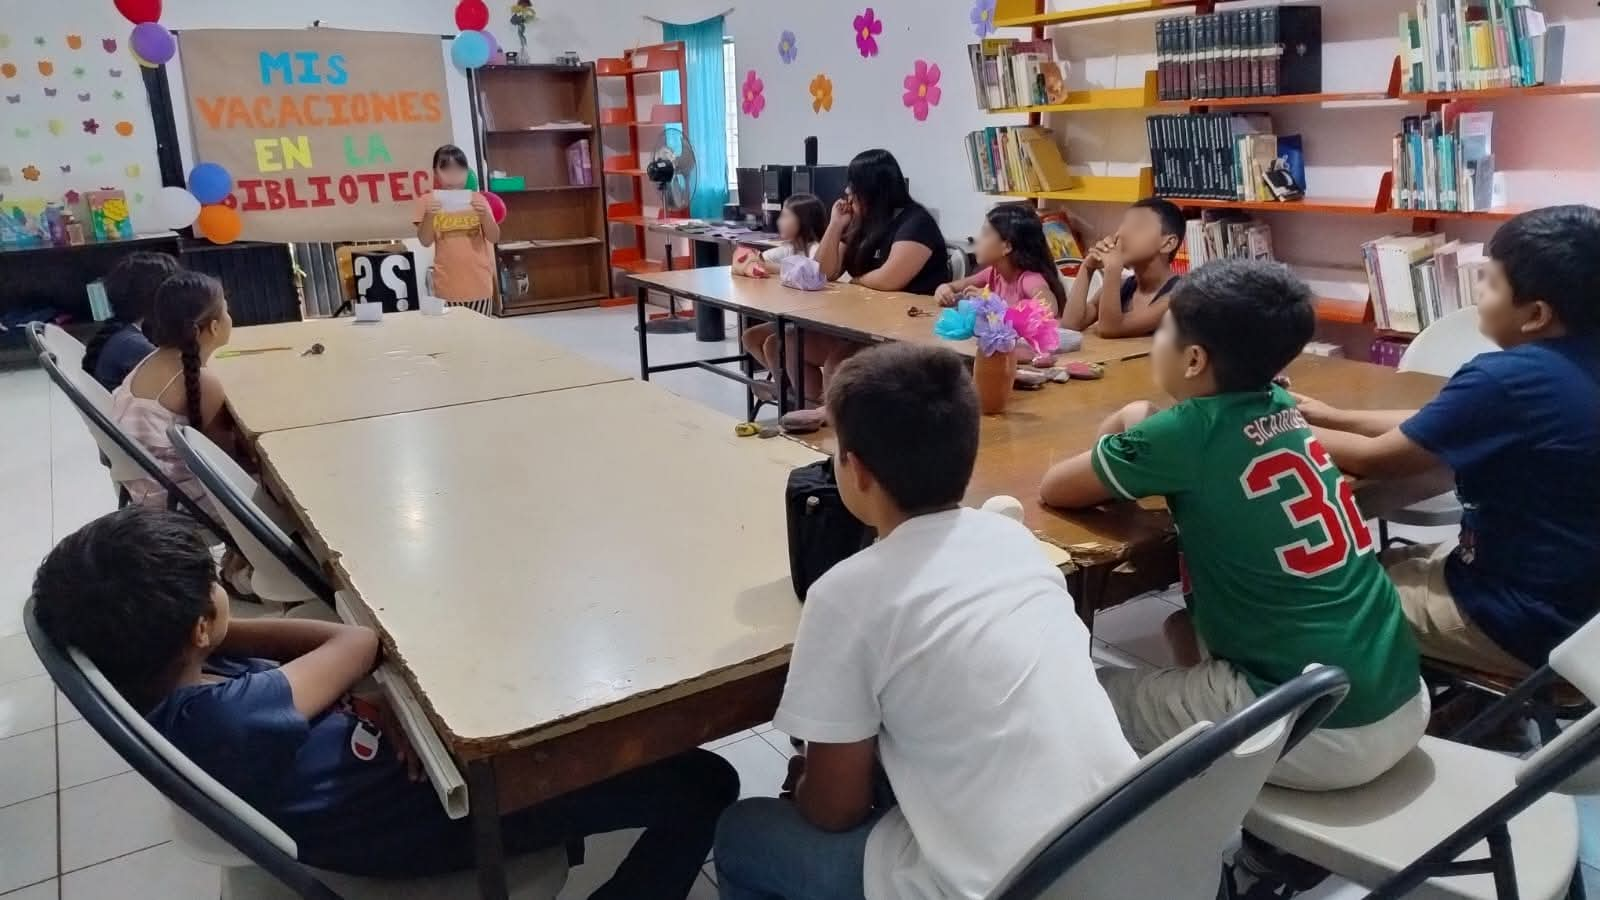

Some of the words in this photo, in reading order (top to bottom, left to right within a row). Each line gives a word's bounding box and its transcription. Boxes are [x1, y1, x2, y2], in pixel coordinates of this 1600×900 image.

[259, 51, 348, 85] MIS
[195, 92, 442, 129] VACACIONES
[254, 136, 313, 172] EN
[343, 133, 392, 167] LA
[221, 170, 442, 212] IBLIOTEC
